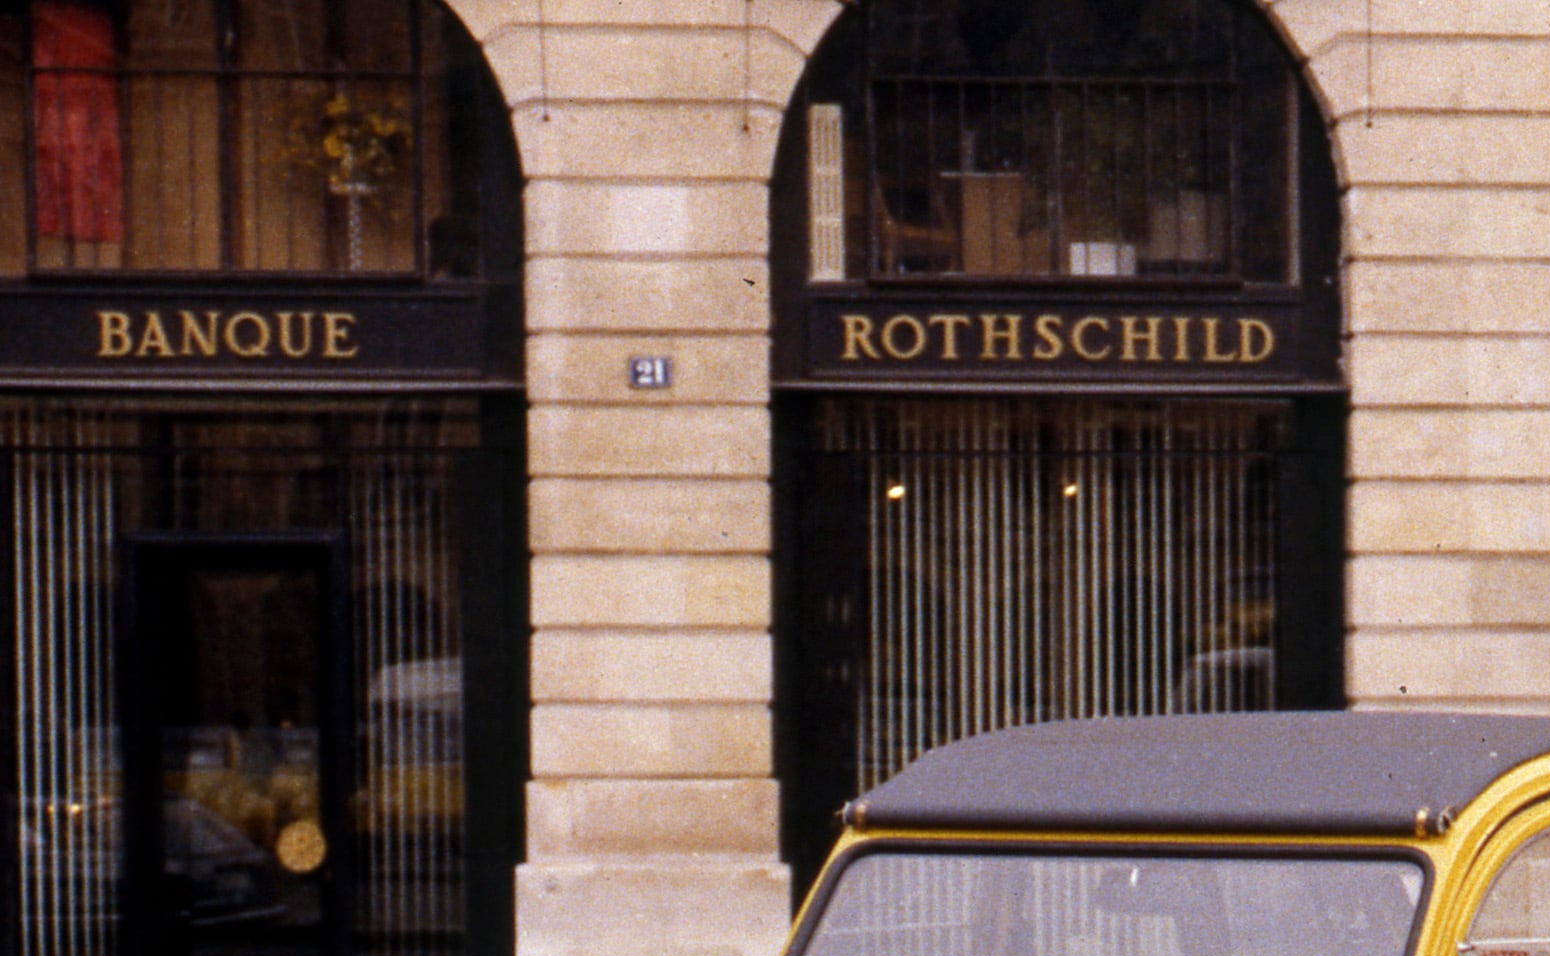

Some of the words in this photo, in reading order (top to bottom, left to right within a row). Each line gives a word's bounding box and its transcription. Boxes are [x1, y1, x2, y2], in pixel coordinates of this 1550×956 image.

[96, 310, 360, 358] BANQUE
[839, 313, 1276, 363] ROTHSCHILD
[635, 357, 665, 385] 21
